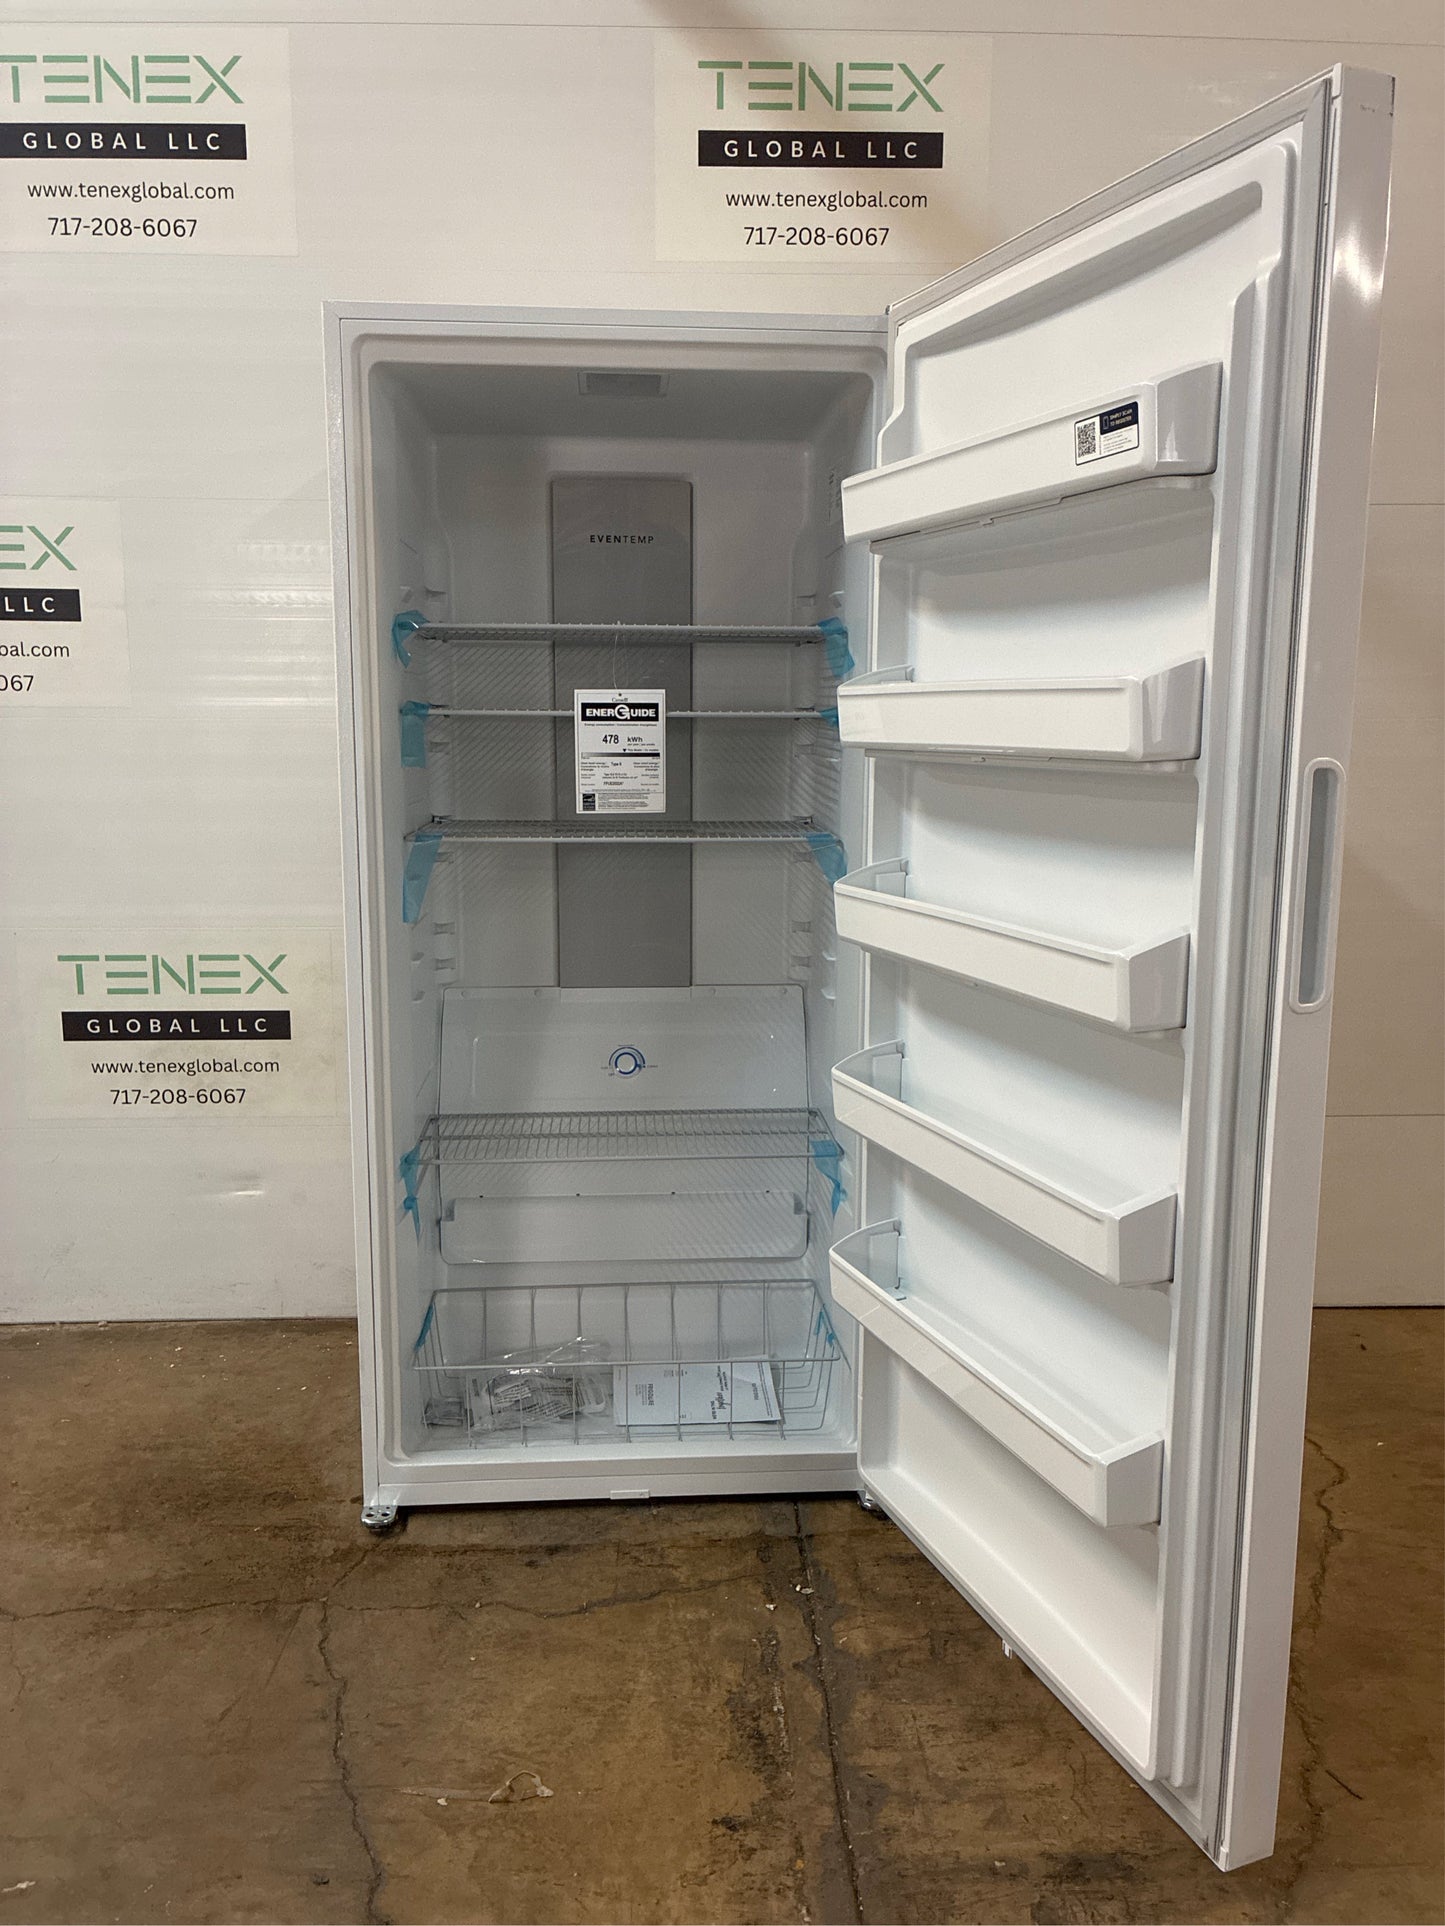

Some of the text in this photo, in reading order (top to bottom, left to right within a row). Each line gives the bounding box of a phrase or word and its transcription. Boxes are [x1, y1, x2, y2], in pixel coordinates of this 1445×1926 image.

[0, 55, 244, 104] TENEX
[698, 61, 945, 112] TENEX
[22, 132, 220, 151] GLOBAL LLC
[723, 140, 917, 159] GLOBAL LLC
[27, 181, 235, 203] www.tenexglobal.com
[725, 191, 928, 212] www.tenexglobal.com
[47, 217, 198, 238] 717-208-6067
[743, 227, 890, 246] 717-208-6067
[589, 534, 654, 544] EVENTEMP
[4, 596, 55, 613] LLC
[602, 734, 619, 744] 478
[57, 954, 289, 995] TENEX
[86, 1018, 267, 1033] GLOBAL LLC
[91, 1058, 280, 1077] www.tenexglobal.com
[110, 1088, 246, 1105] 717-208-6067
